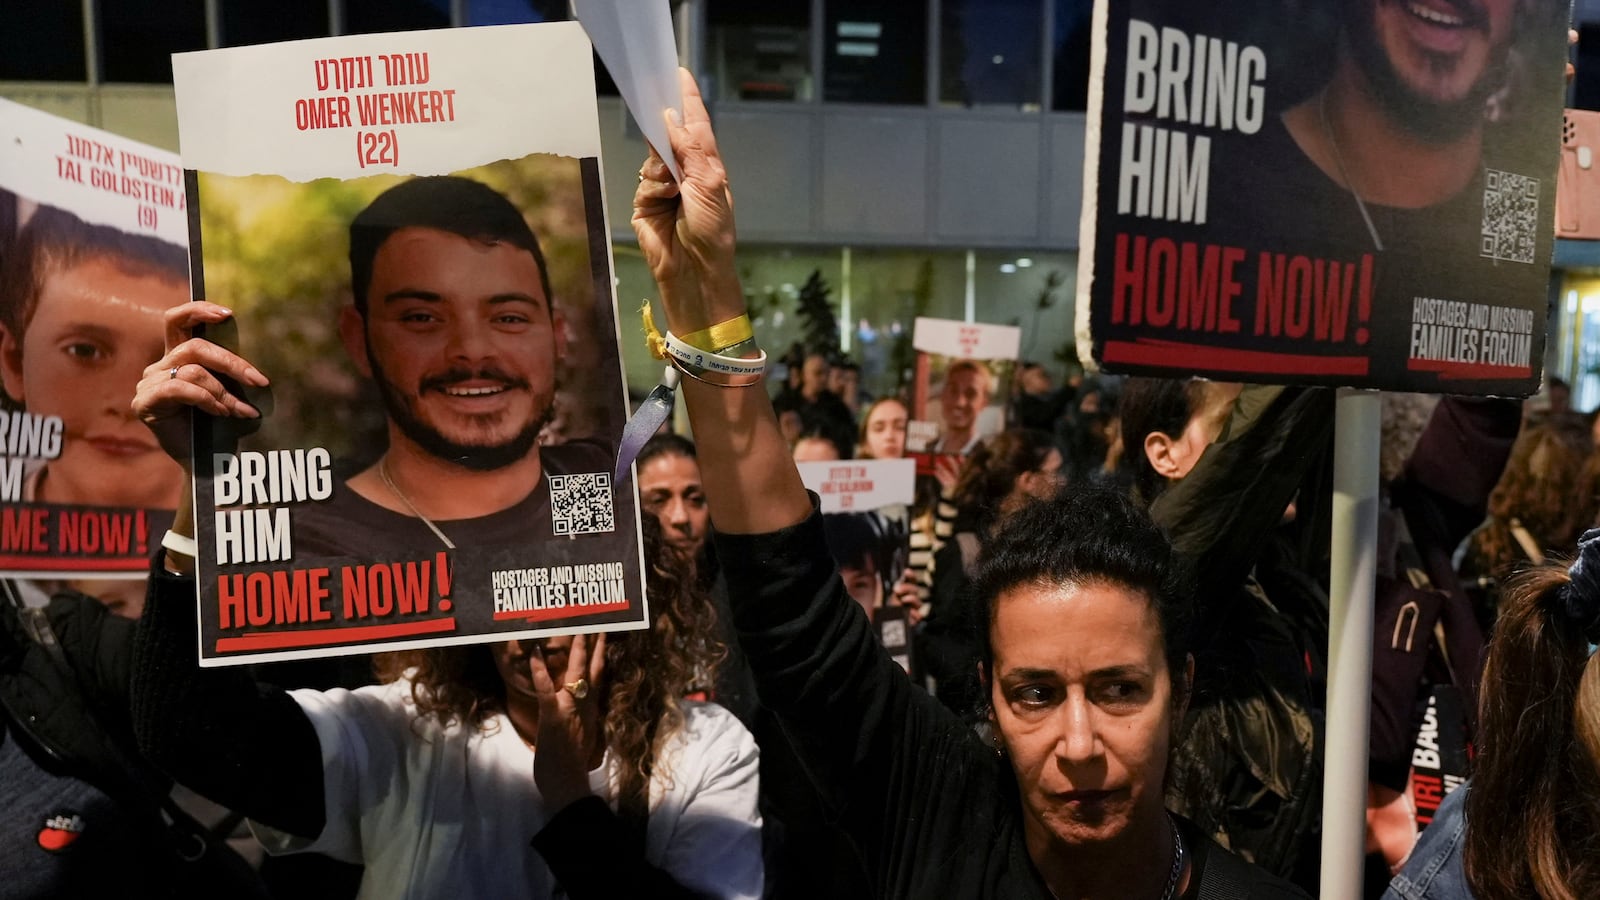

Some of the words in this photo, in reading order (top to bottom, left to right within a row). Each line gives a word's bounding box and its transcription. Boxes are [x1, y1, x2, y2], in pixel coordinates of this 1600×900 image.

[314, 56, 374, 93] ונקרט
[378, 52, 430, 86] עומר
[1124, 19, 1267, 135] BRING
[295, 97, 352, 131] OMER
[356, 90, 456, 126] WENKERT
[356, 129, 399, 168] (22)
[56, 155, 84, 184] TAL
[90, 166, 175, 209] GOLDSTEIN
[1117, 121, 1211, 225] HIM
[137, 203, 158, 231] (9)
[1111, 232, 1246, 333] HOME
[1255, 251, 1374, 346] NOW!
[1412, 296, 1468, 328] HOSTAGES
[1468, 303, 1489, 330] AND
[1490, 305, 1534, 335] MISSING
[1410, 323, 1479, 364] FAMILIES
[1480, 330, 1532, 369] FORUM
[213, 447, 333, 506] BRING
[58, 509, 148, 555] NOW!
[215, 507, 292, 565] HIM
[217, 567, 332, 630] HOME
[342, 551, 453, 619] NOW!
[492, 567, 549, 589] HOSTAGES
[550, 566, 573, 585] AND
[574, 561, 624, 583] MISSING
[493, 584, 566, 613] FAMILIES
[568, 579, 626, 607] FORUM
